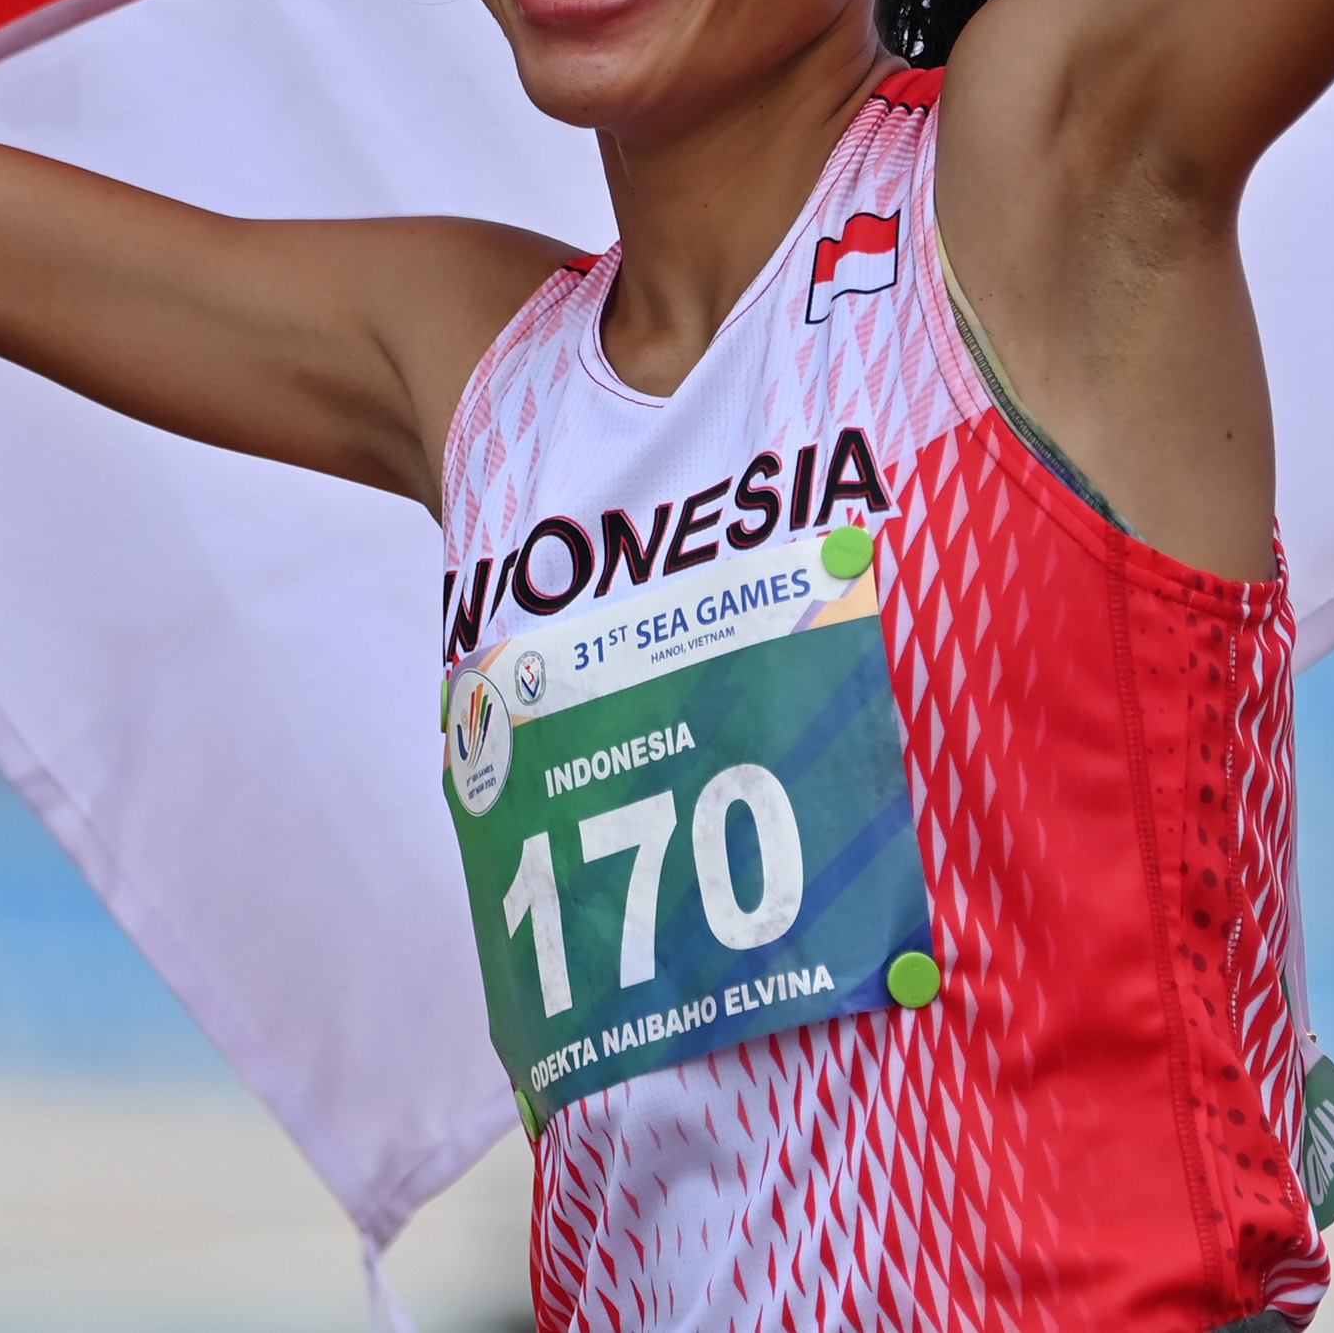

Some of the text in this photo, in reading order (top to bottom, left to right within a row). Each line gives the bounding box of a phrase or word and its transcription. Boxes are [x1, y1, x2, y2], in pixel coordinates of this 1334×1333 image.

[574, 569, 811, 670] 31ST SEA GAMES
[651, 626, 735, 664] HANOI, VIETNAM
[545, 722, 696, 798] INDONESIA
[502, 763, 804, 1019] 170
[530, 965, 835, 1093] ODEKTA NAIBAHO ELVINA
